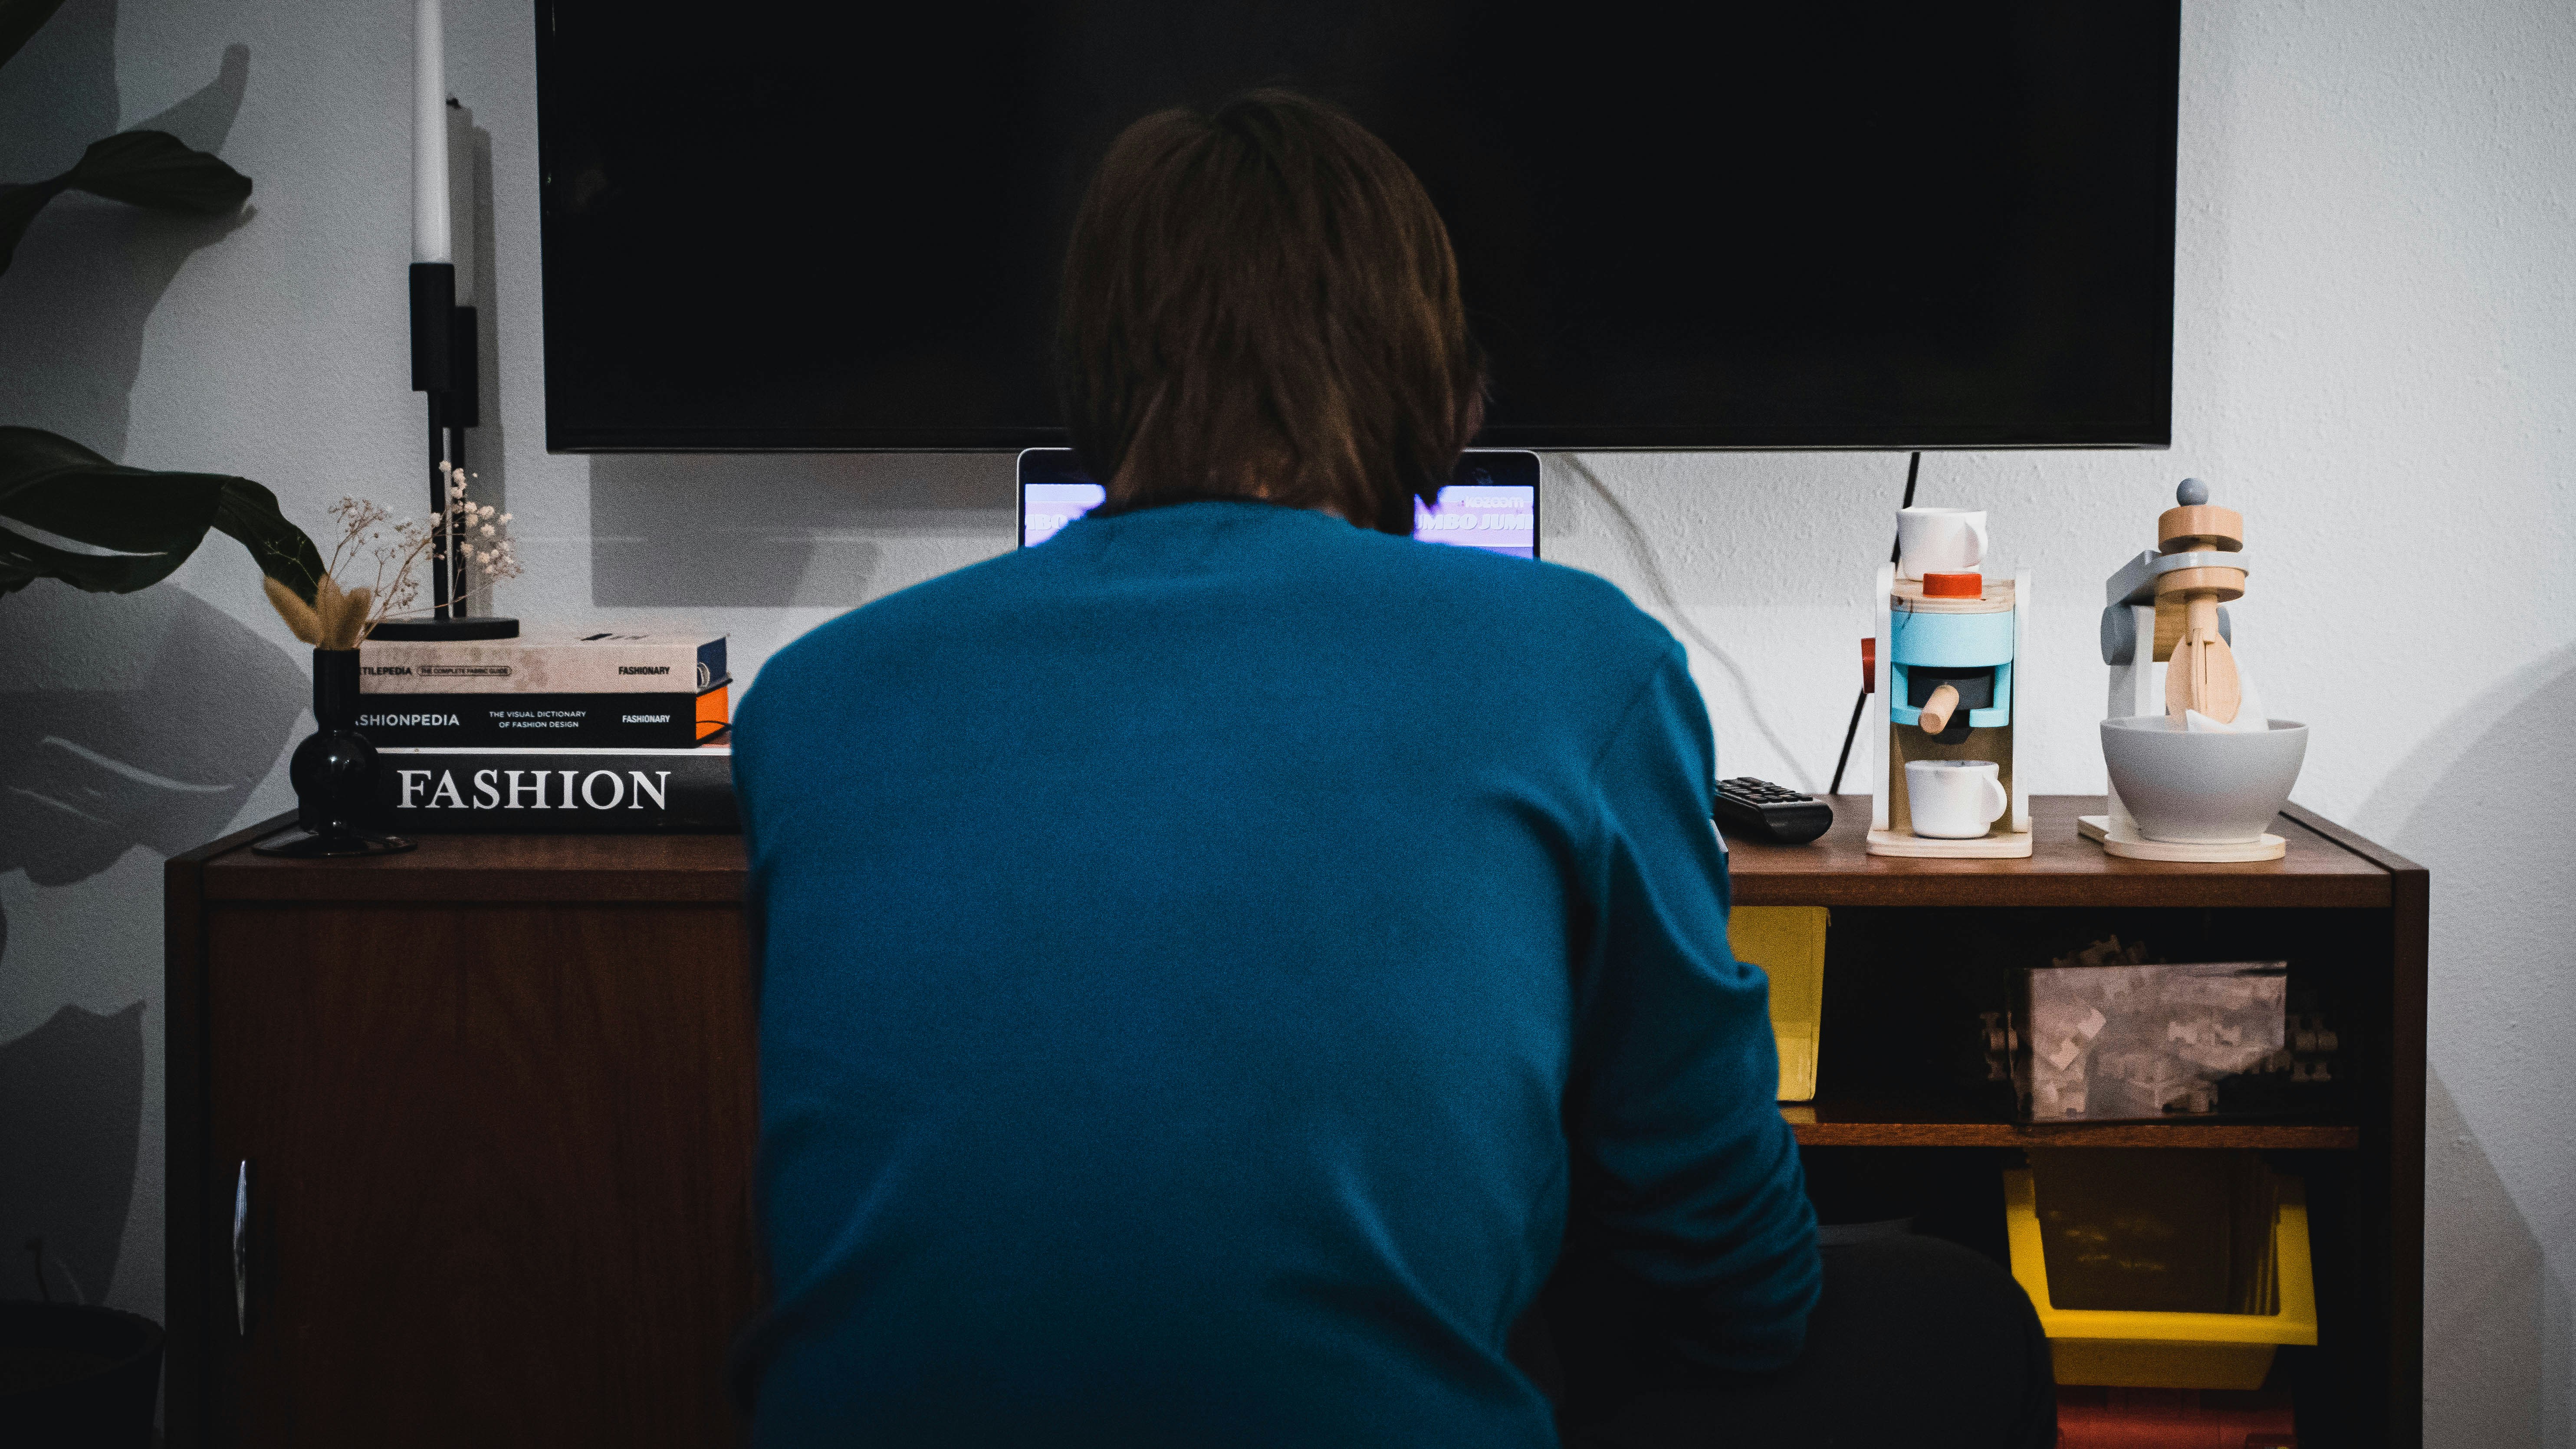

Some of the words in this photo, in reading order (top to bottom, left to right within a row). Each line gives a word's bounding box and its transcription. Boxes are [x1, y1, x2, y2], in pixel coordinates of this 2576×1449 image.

[1419, 514, 1477, 530] MBO
[360, 666, 413, 675] TILEPEDIA
[618, 666, 670, 675] FASHIONARY
[622, 715, 670, 723] FASHIONARY
[397, 769, 671, 810] FASHION
